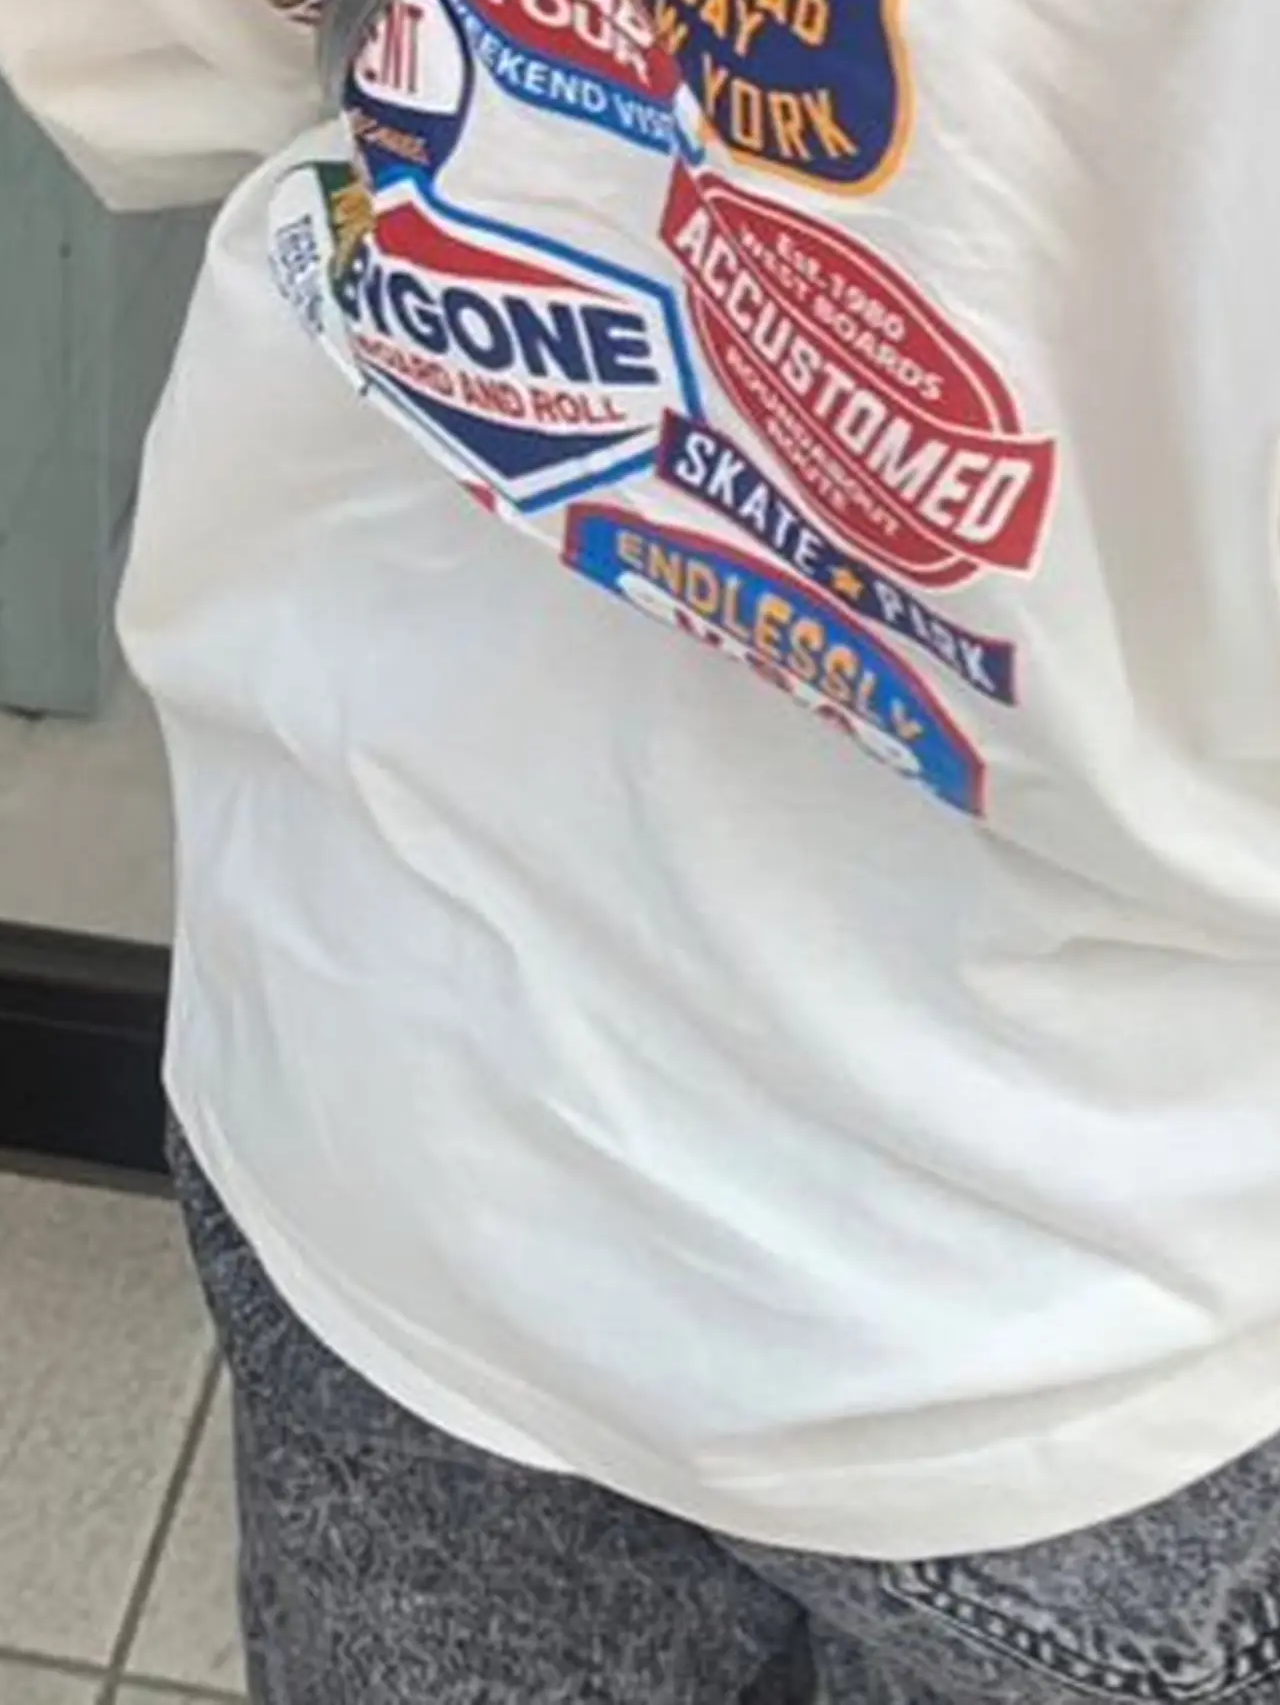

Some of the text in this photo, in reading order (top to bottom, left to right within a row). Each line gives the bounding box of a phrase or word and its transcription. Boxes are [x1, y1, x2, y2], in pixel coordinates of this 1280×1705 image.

[700, 49, 859, 161] YORK
[527, 384, 627, 425] ROLL
[673, 208, 1034, 547] ACCUSTOMED
[674, 429, 822, 575] SKATE
[616, 527, 926, 743] ENDLESSLY
